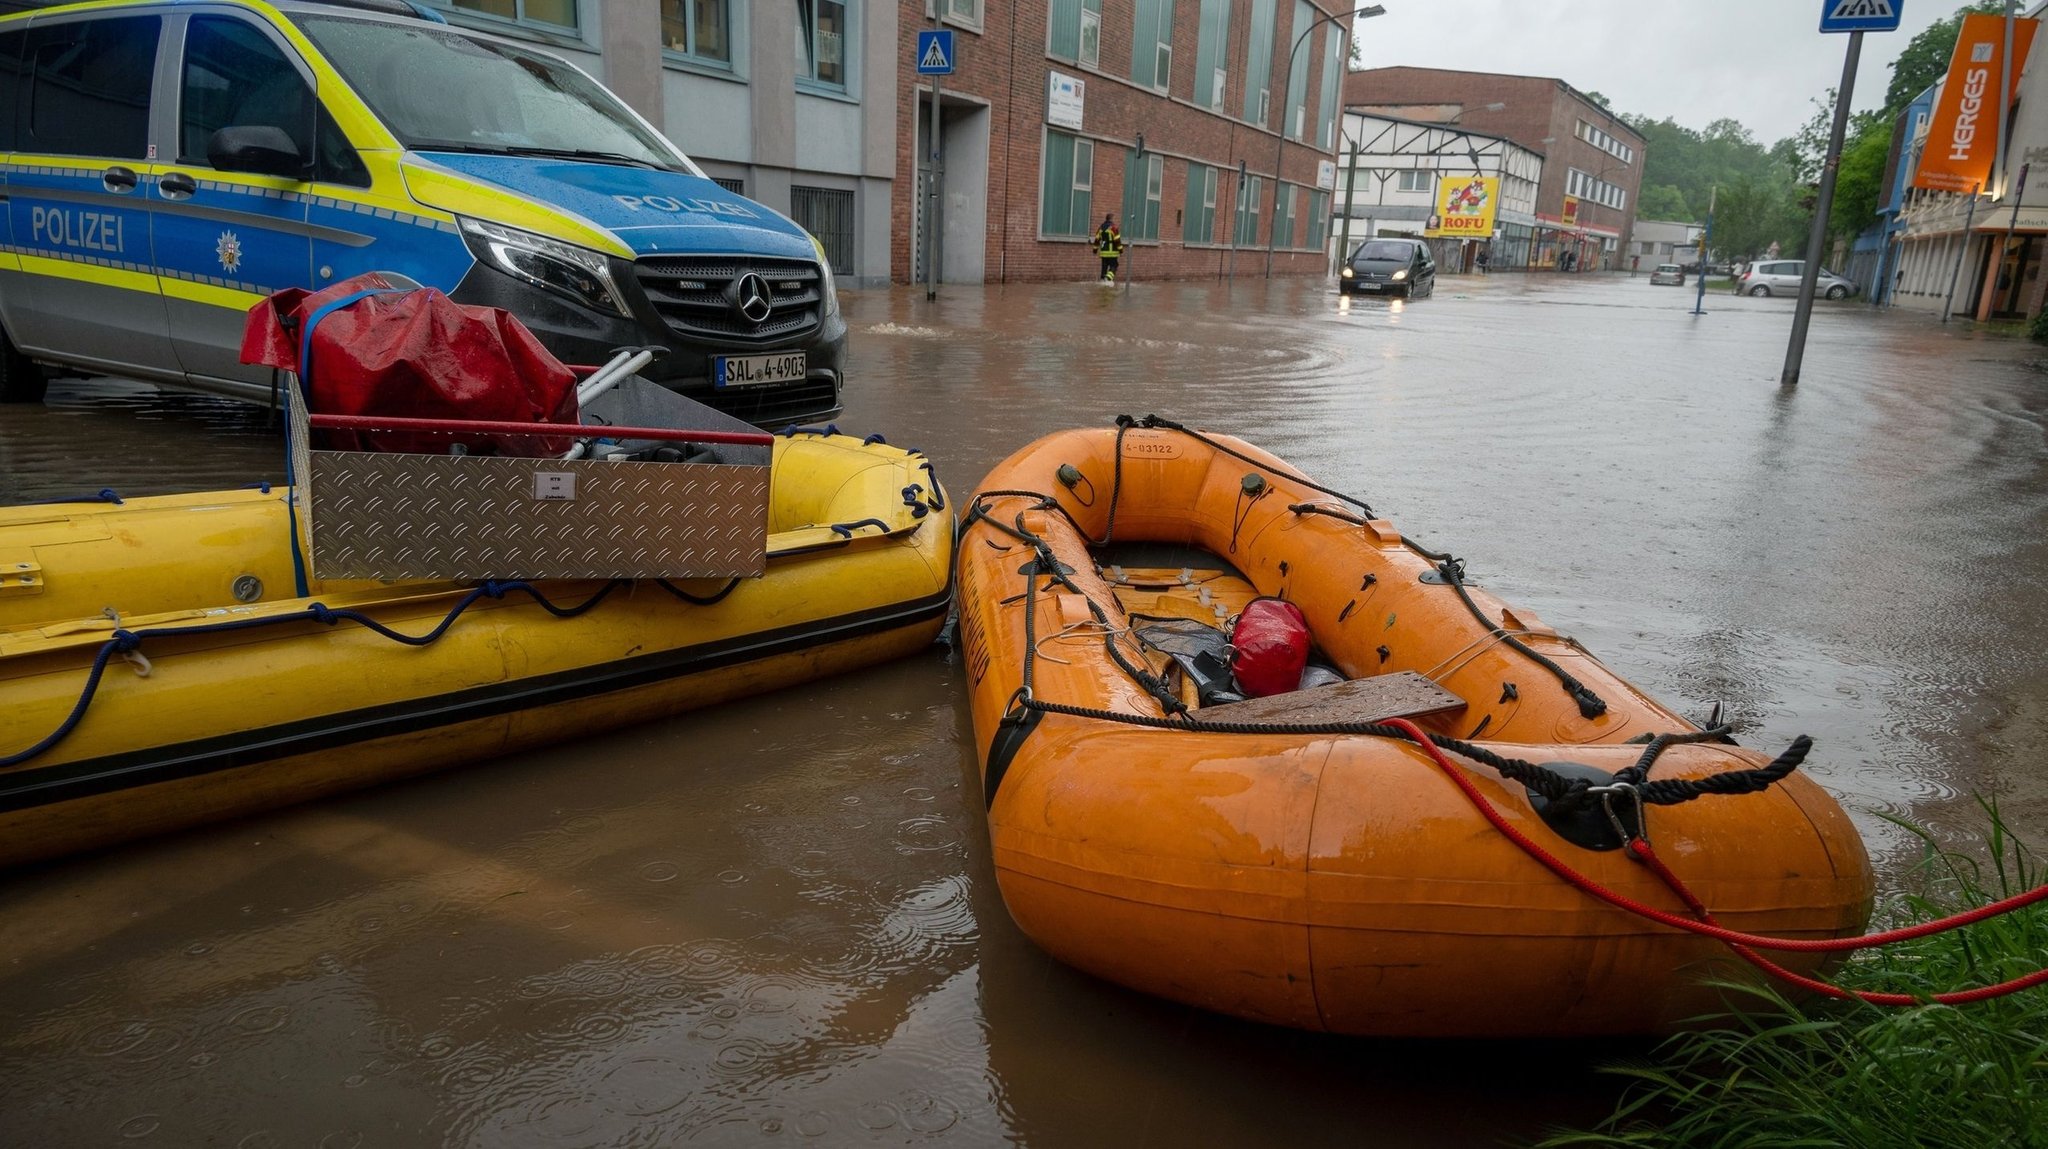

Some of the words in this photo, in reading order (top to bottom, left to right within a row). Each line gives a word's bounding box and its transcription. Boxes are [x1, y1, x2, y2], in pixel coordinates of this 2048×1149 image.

[1949, 69, 1988, 160] HERGES
[612, 195, 761, 220] POLIZEI
[32, 206, 124, 252] POLIZEI
[1444, 217, 1485, 229] ROFU
[726, 360, 754, 382] SAL
[764, 356, 805, 379] 4-4903
[1126, 443, 1173, 454] 4-03122
